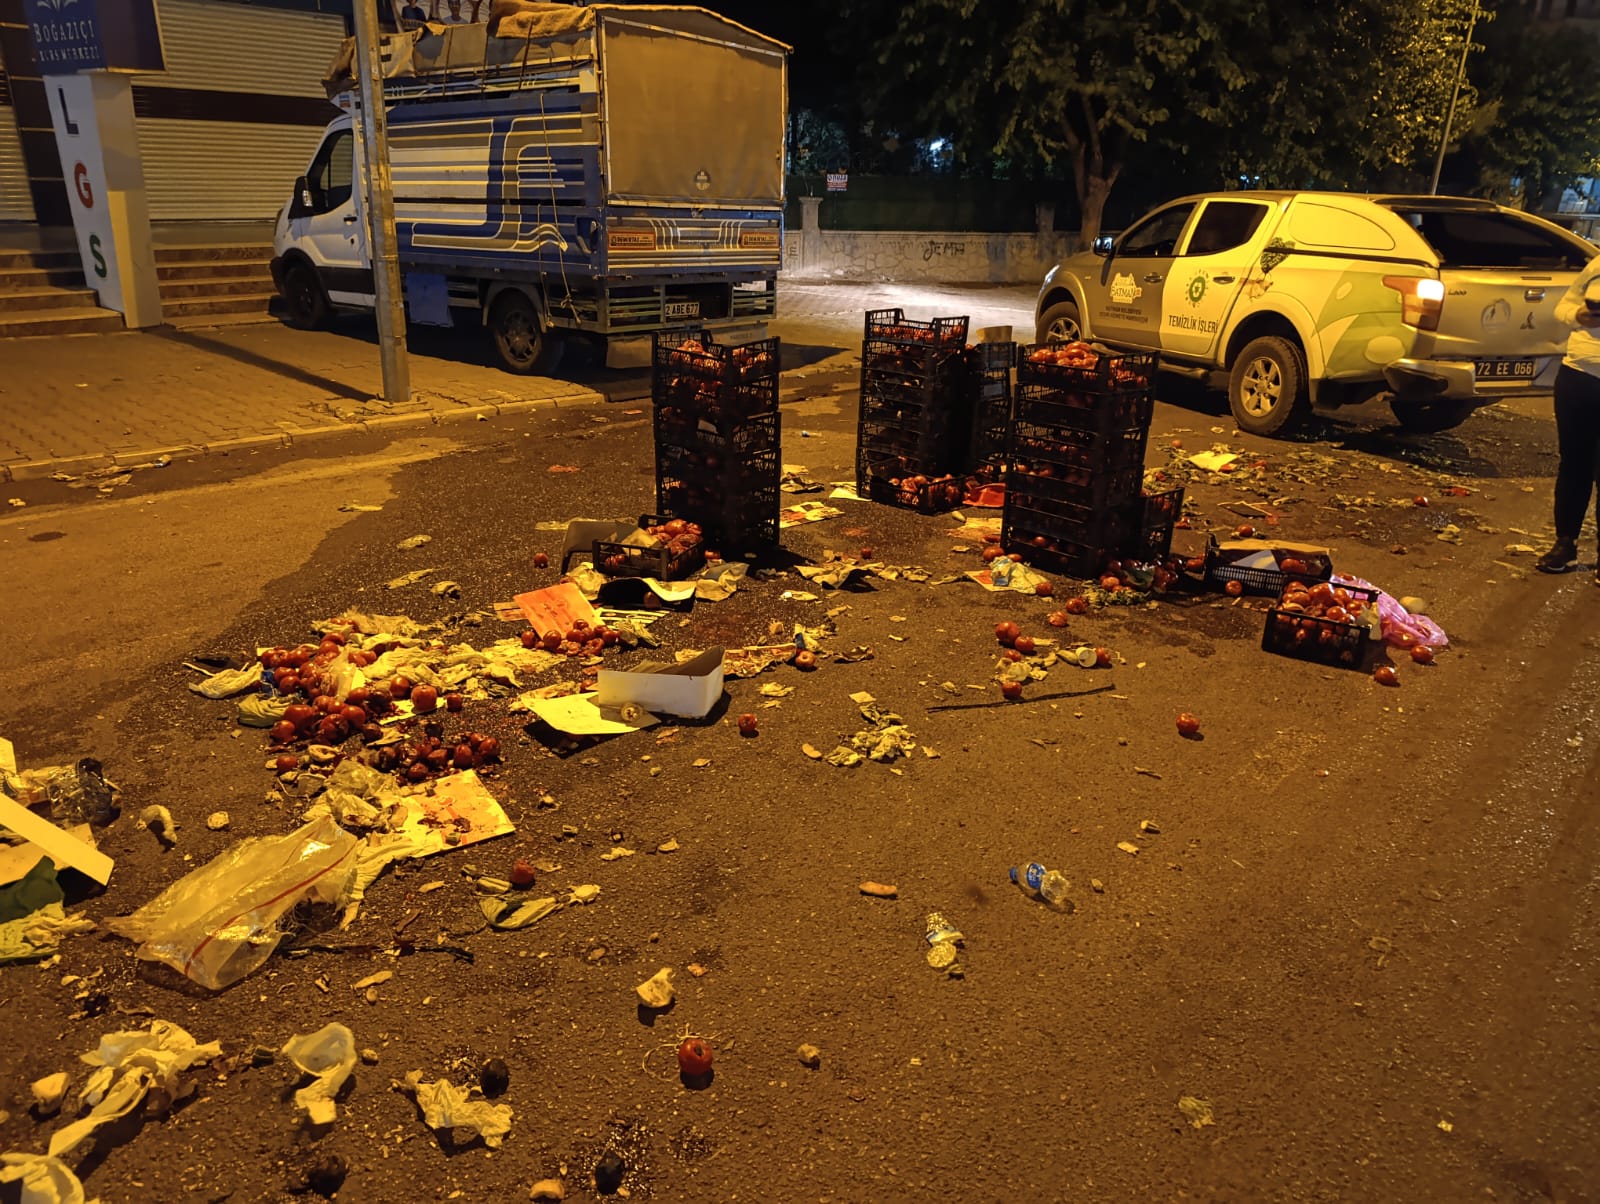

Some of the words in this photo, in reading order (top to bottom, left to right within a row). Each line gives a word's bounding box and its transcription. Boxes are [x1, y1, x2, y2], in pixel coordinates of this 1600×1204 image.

[1168, 314, 1197, 331] TEMİZLİK
[1198, 316, 1219, 334] İŞLERİ
[1478, 362, 1491, 376] 72
[1496, 362, 1510, 375] EE
